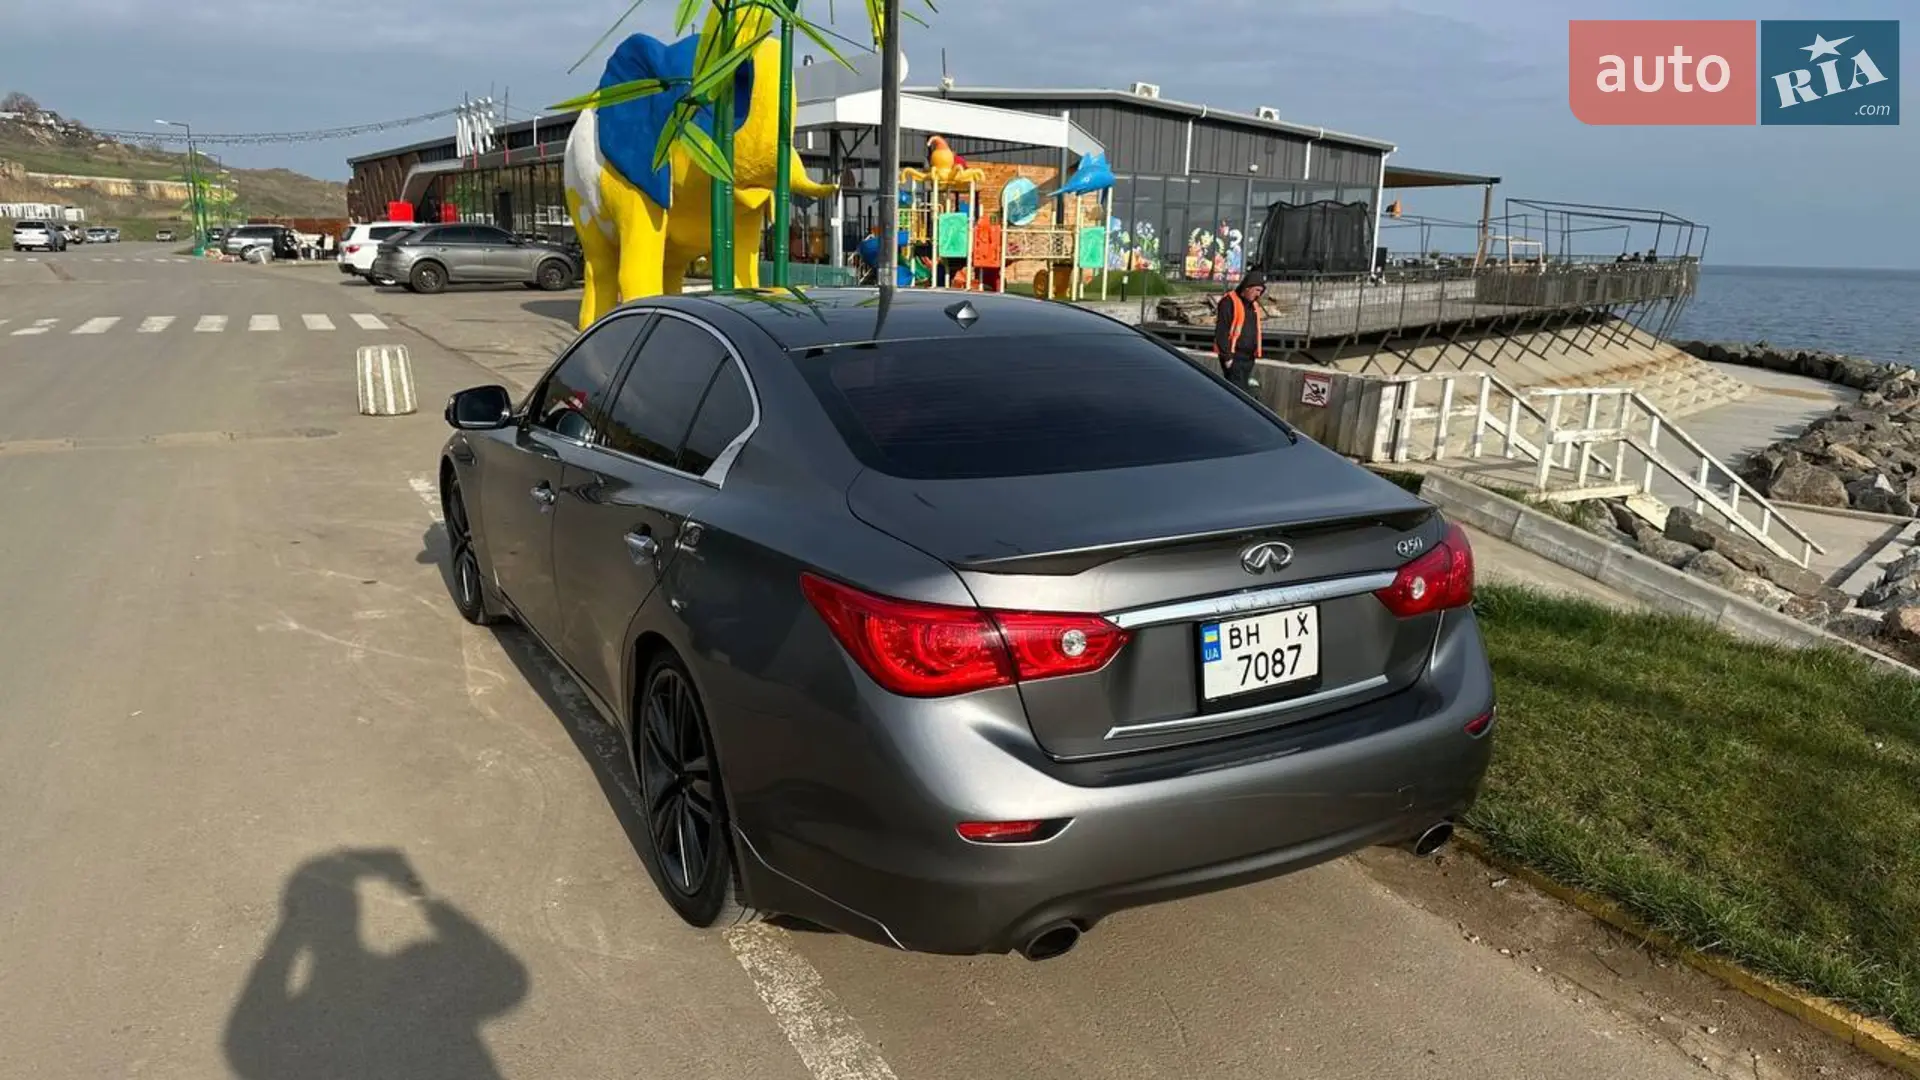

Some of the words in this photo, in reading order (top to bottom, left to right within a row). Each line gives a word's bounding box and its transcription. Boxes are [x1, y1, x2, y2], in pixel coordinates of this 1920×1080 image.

[1397, 536, 1423, 554] Q50
[1229, 623, 1260, 650] BH
[1284, 613, 1309, 639] IX
[1204, 647, 1219, 660] UA
[1237, 643, 1302, 686] 7087
